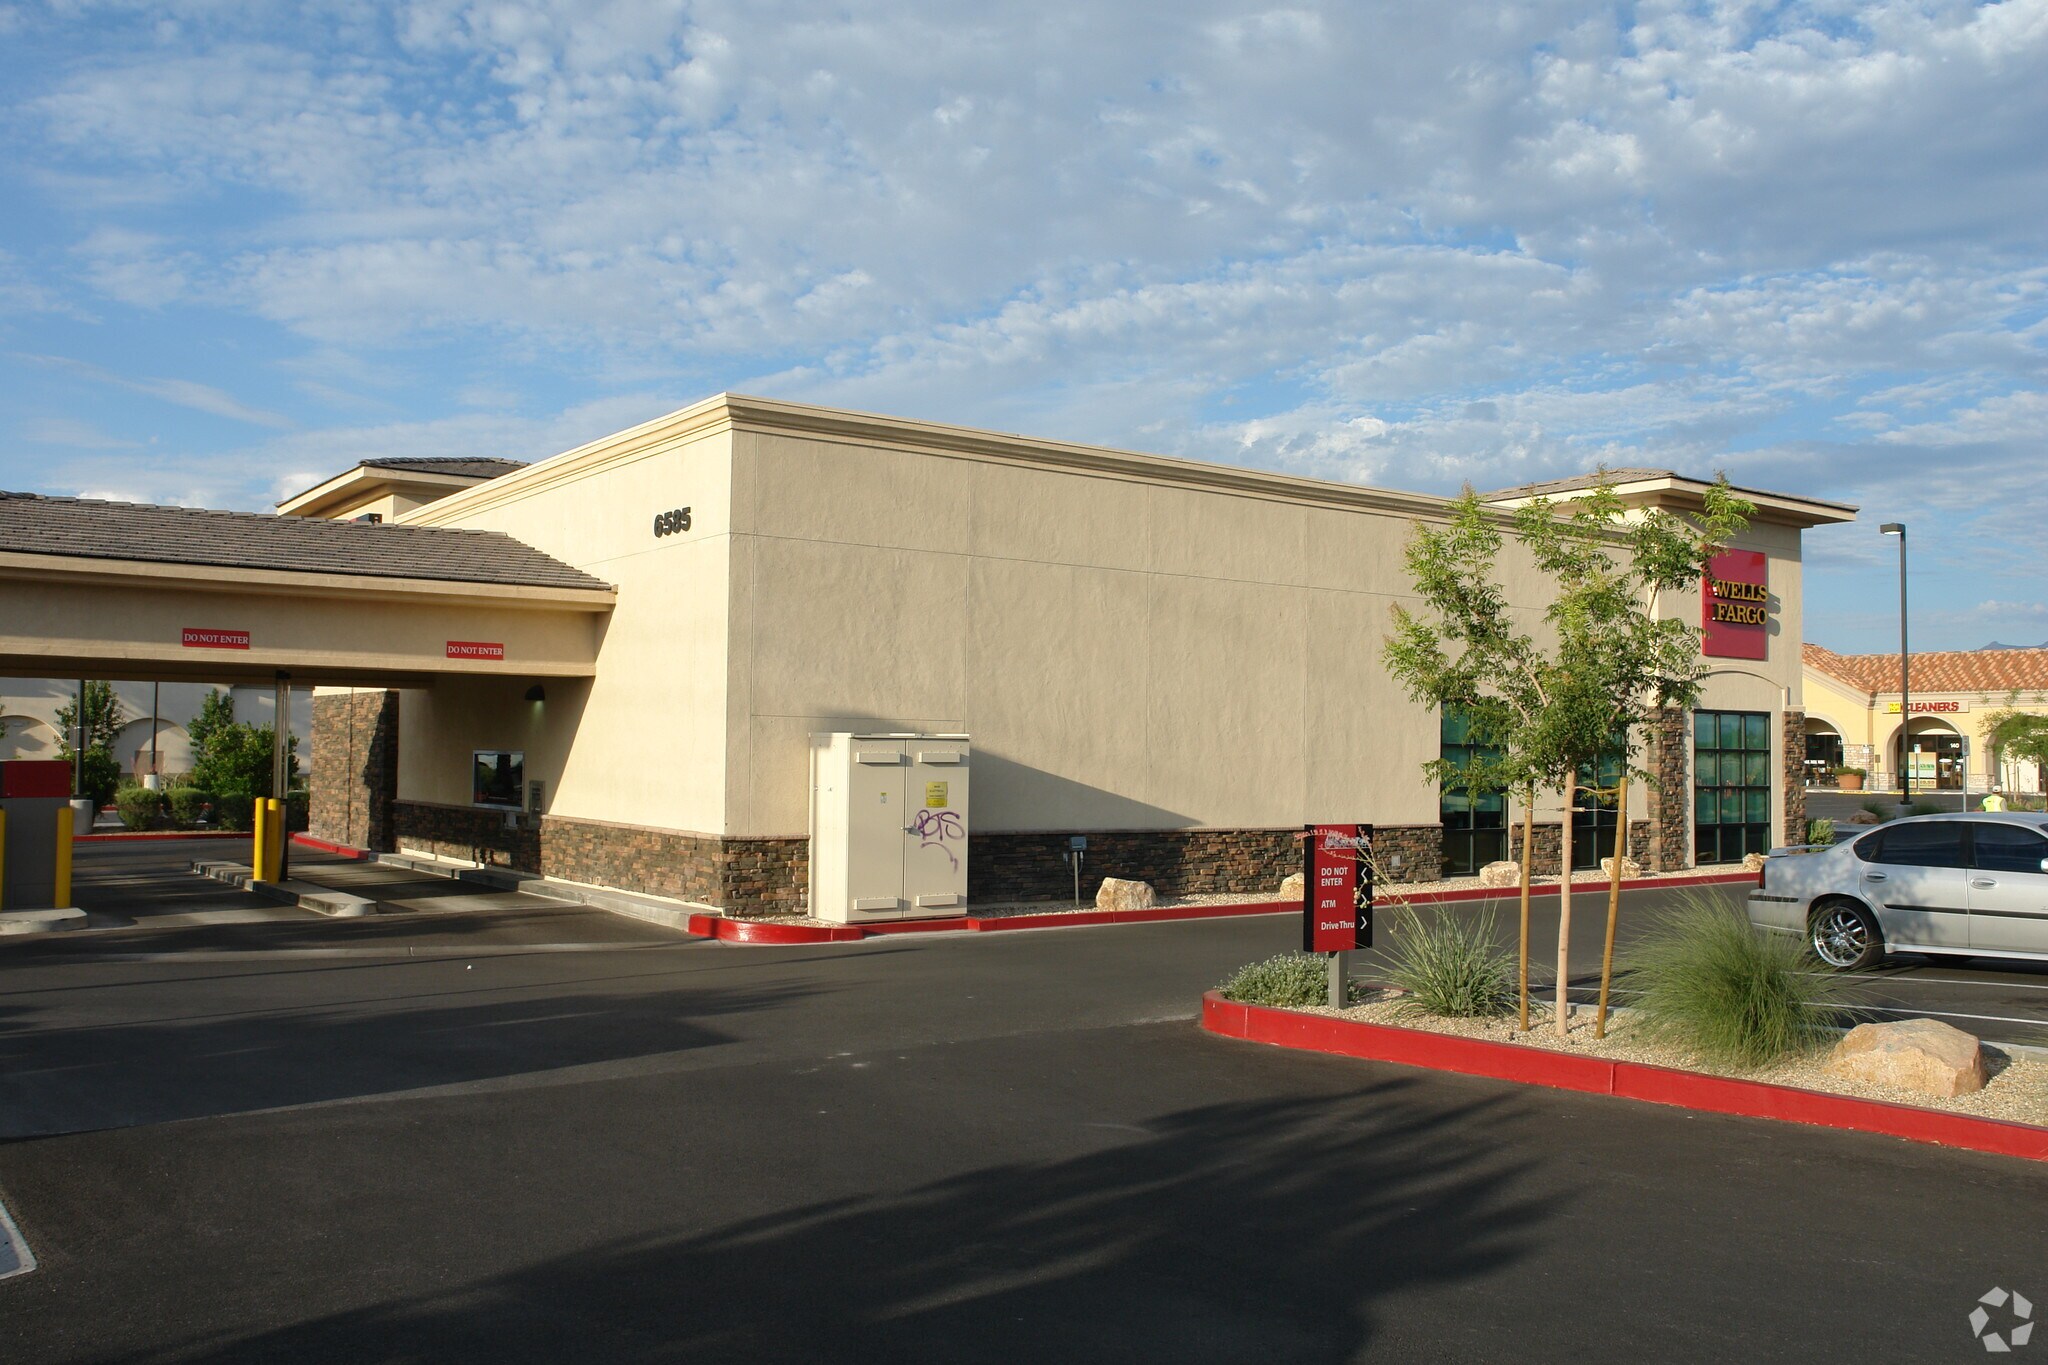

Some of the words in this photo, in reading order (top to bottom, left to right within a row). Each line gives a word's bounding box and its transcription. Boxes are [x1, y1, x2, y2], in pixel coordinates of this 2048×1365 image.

[654, 506, 692, 538] 6585
[1716, 579, 1769, 603] WELLS
[1716, 603, 1768, 625] FARGO
[184, 633, 198, 642] DO
[199, 634, 219, 643] NOT
[220, 635, 249, 645] ENTER
[448, 645, 460, 654] DO
[460, 646, 478, 655] NOT
[478, 647, 503, 656] ENTER
[1321, 867, 1332, 876] DO
[1333, 866, 1349, 876] NOT
[1321, 877, 1343, 887] ENTER
[1321, 899, 1336, 909] ATM
[1321, 921, 1339, 930] Drive
[1339, 920, 1355, 929] Thru
